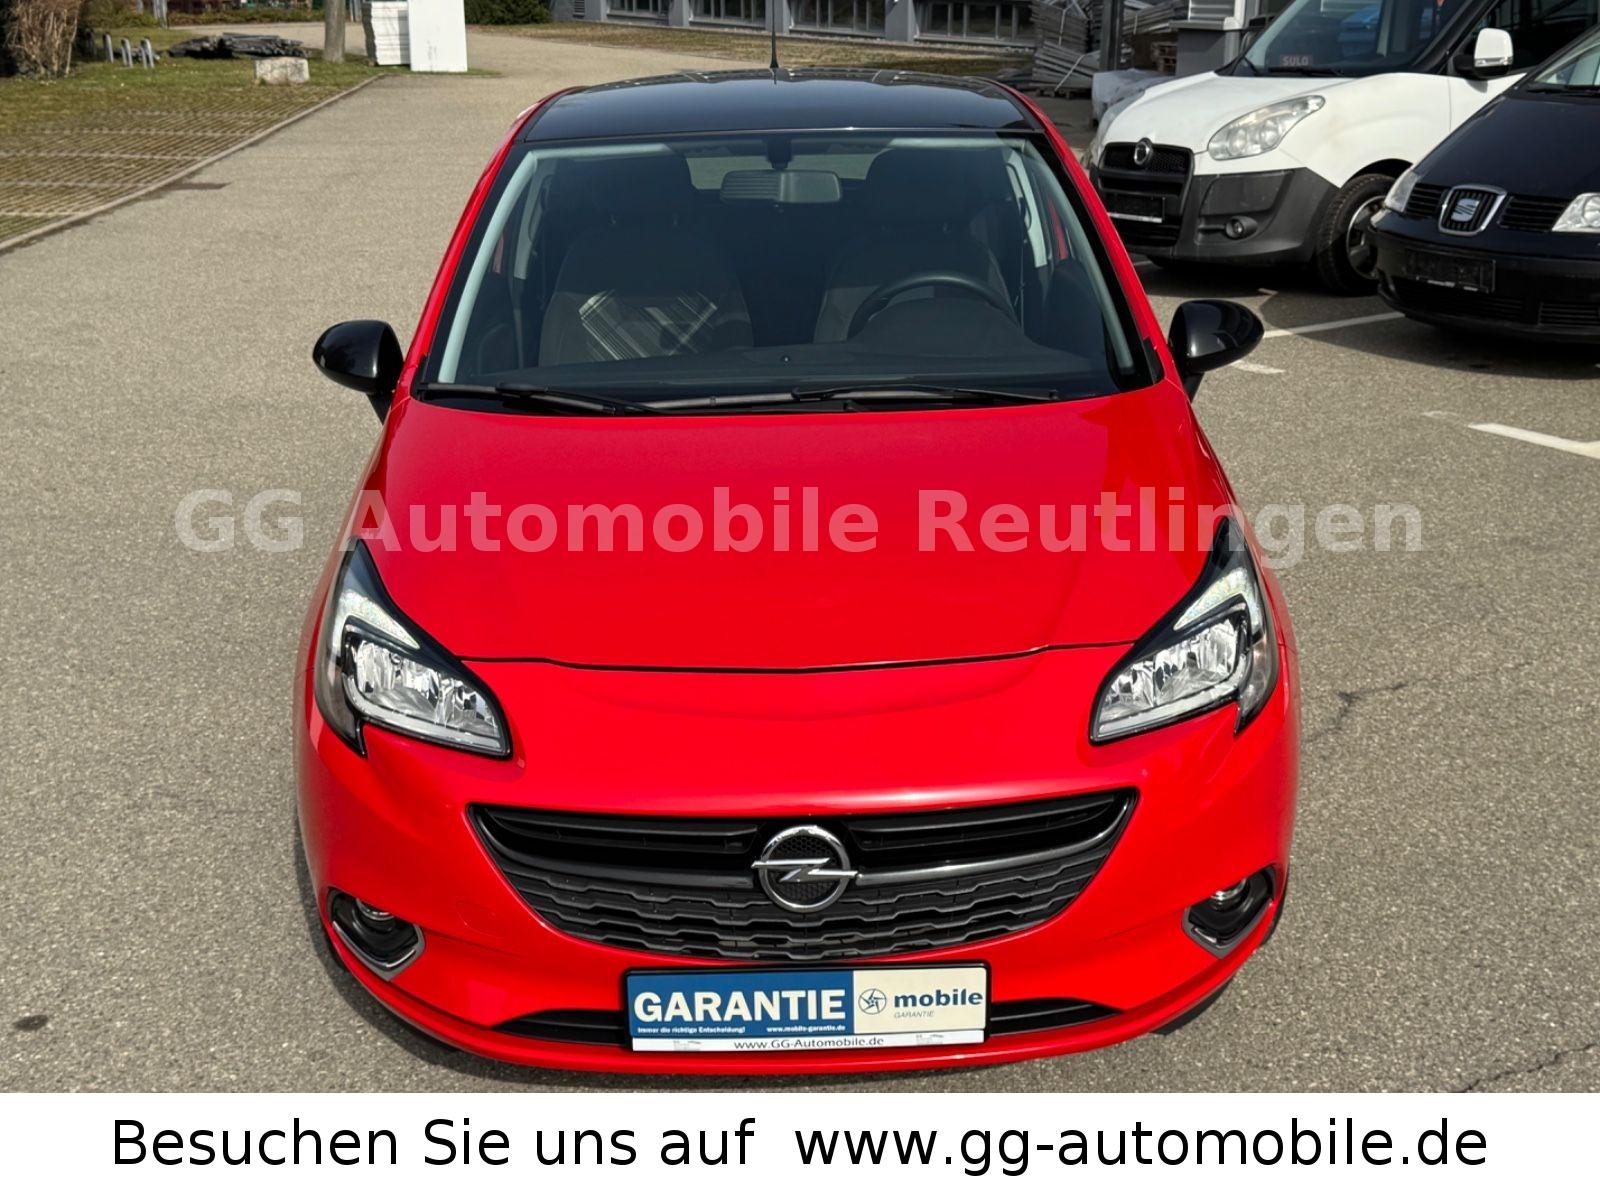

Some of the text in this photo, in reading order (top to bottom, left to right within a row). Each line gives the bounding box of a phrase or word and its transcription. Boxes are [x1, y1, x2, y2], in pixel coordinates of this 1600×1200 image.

[633, 989, 846, 1022] GARANTIE
[894, 988, 984, 1008] mobile
[733, 1036, 884, 1049] www.GG-Automobile.de
